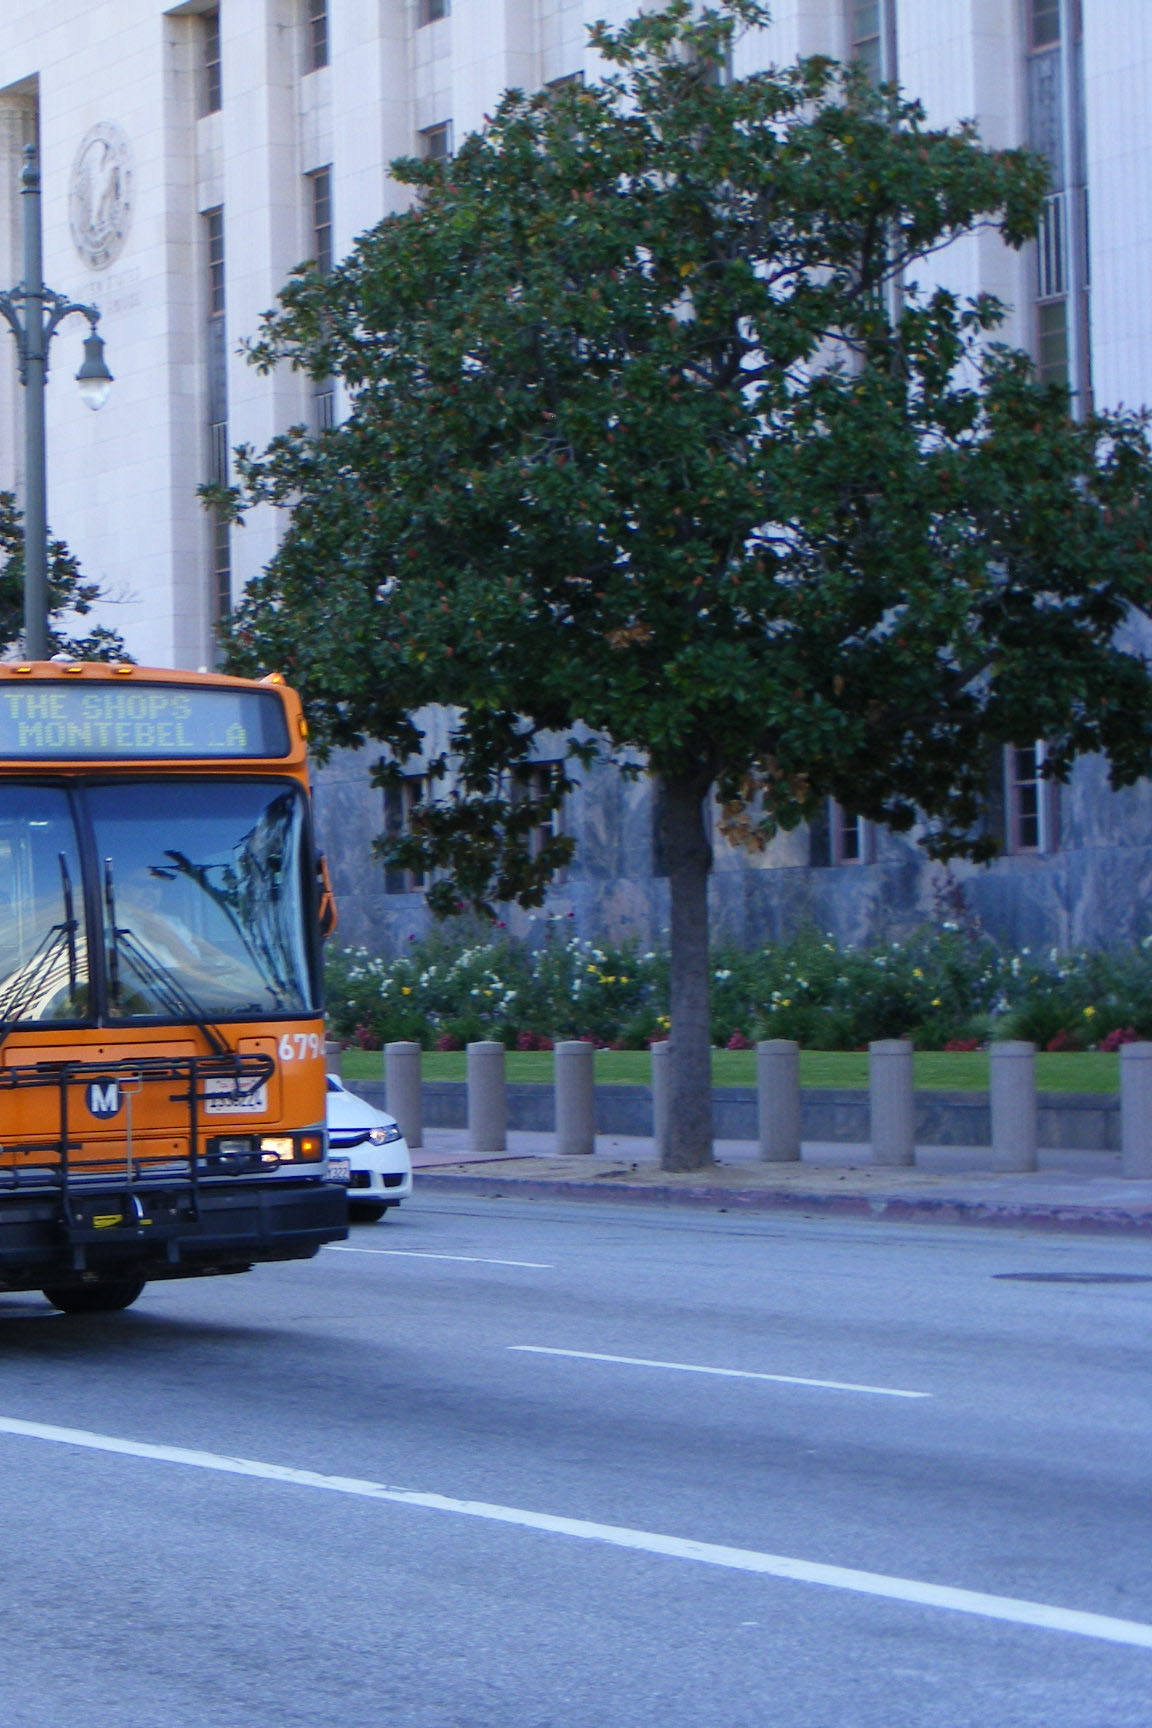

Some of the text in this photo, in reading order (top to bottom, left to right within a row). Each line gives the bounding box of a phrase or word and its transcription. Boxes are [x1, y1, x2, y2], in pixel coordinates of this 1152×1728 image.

[4, 694, 192, 719] THE SHOPS
[18, 722, 194, 747] MONTEBEL
[91, 1083, 118, 1113] M
